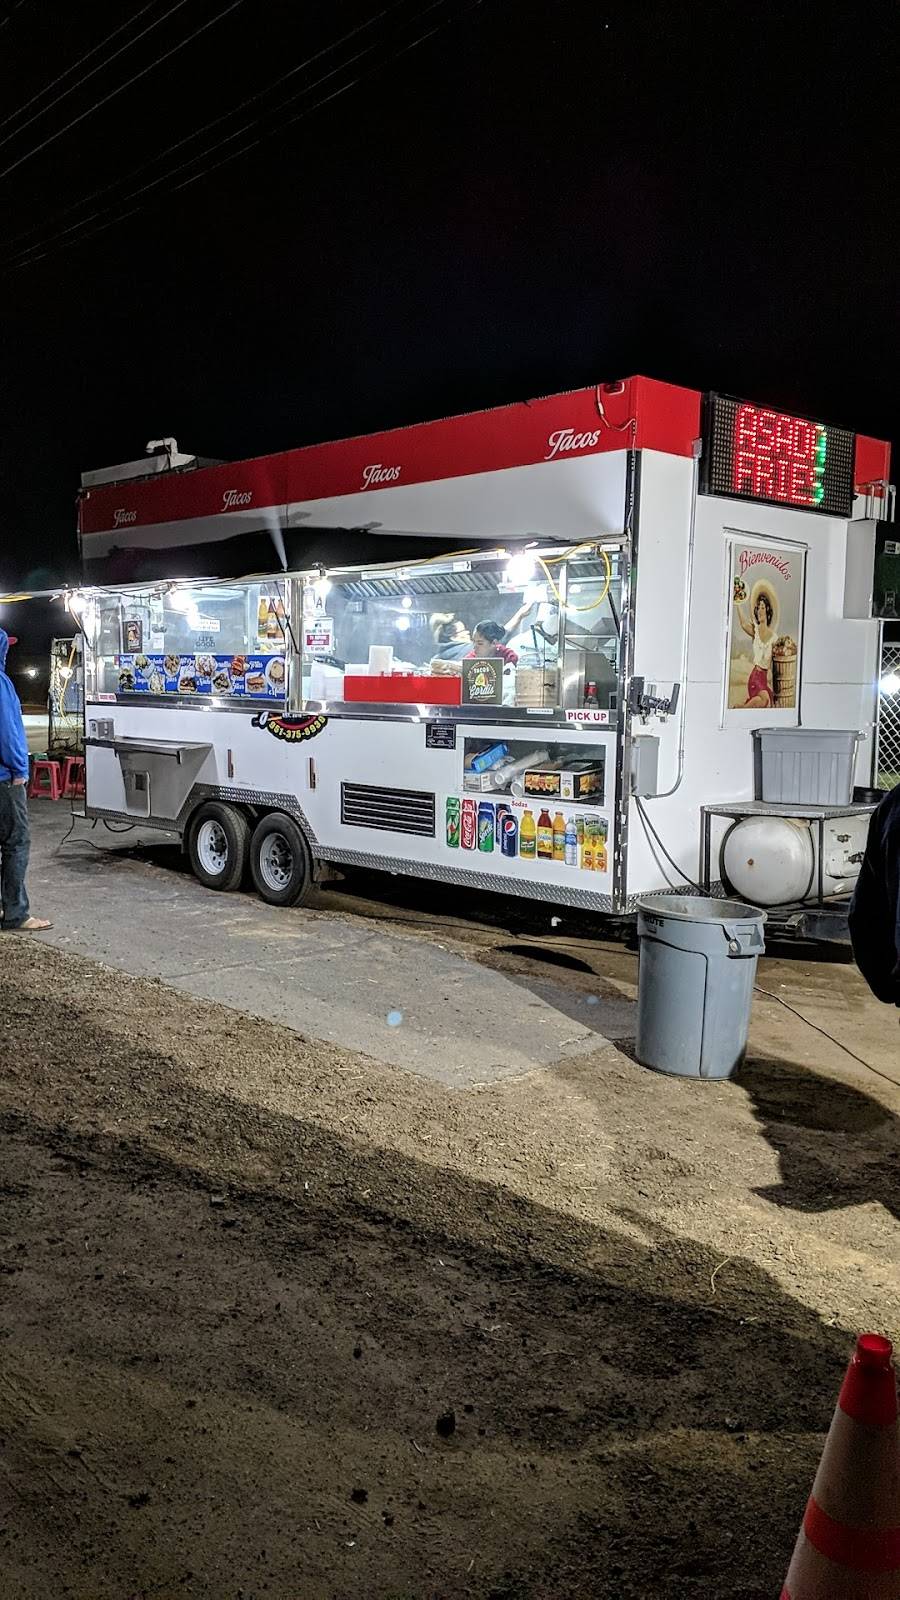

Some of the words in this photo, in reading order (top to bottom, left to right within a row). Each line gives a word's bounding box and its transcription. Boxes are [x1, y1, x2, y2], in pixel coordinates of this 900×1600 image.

[544, 428, 601, 460] Tacos
[739, 406, 827, 463] ASADA
[360, 464, 401, 490] Tacos
[738, 450, 825, 504] FRIES
[221, 489, 253, 512] Tacos
[112, 508, 137, 528] Tacos
[739, 550, 792, 581] Bienvenidos
[315, 597, 323, 608] A
[568, 712, 591, 721] PICK
[593, 713, 607, 721] UP
[511, 800, 528, 808] Sodas
